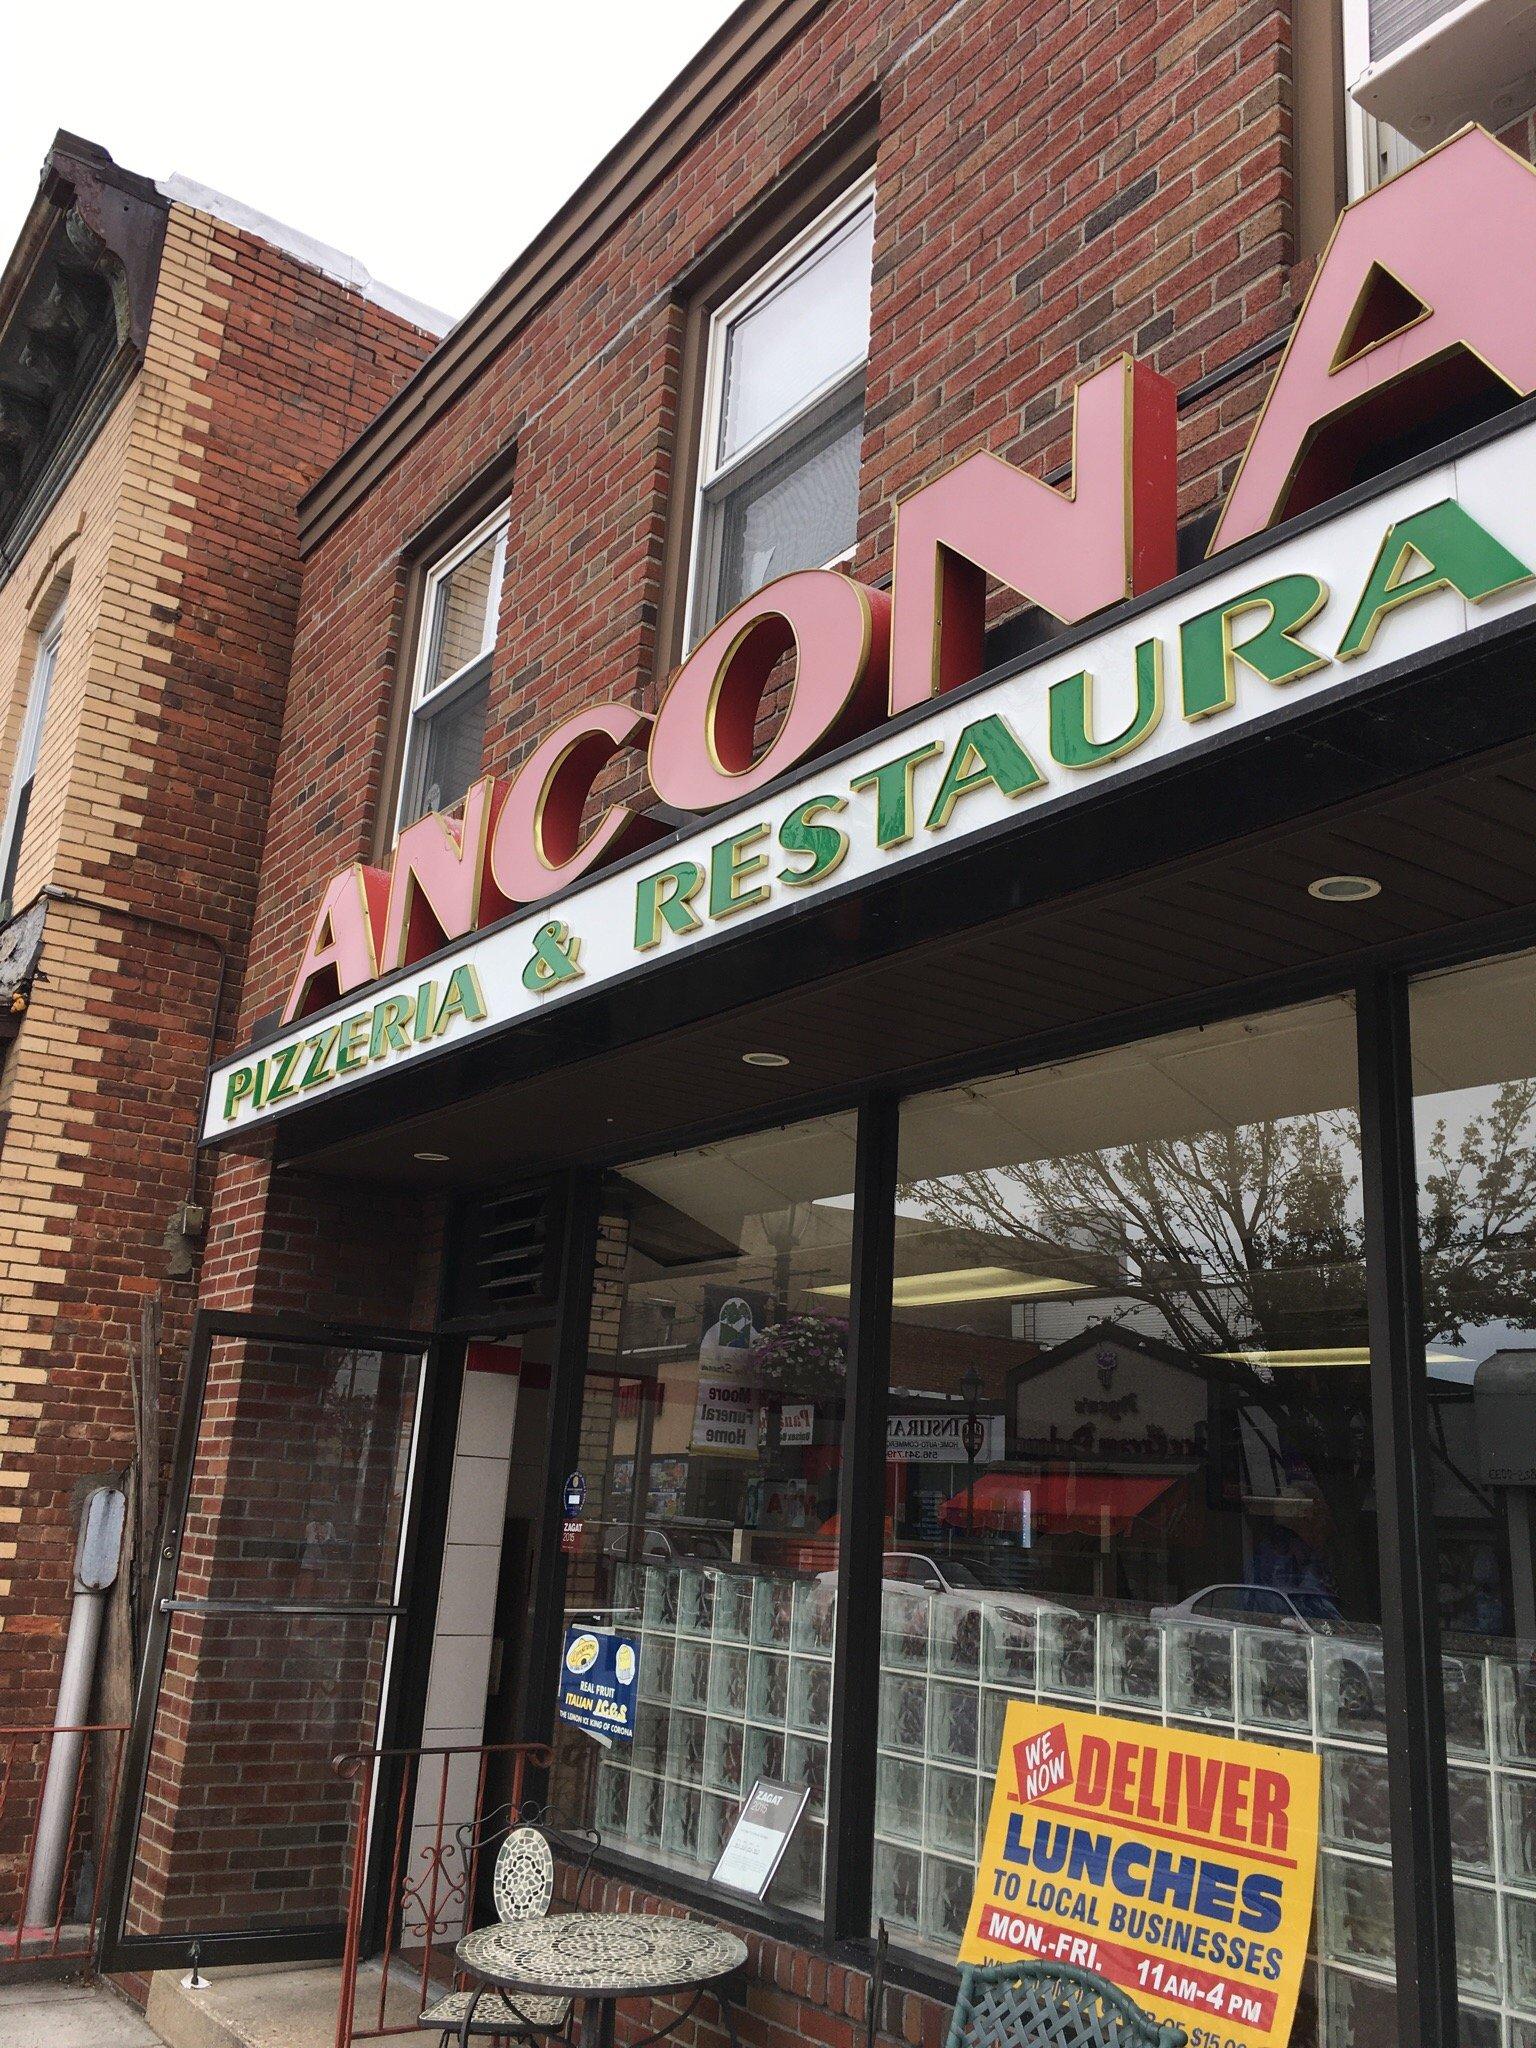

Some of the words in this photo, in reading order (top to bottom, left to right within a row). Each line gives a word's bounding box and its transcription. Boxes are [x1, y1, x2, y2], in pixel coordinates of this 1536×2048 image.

[278, 121, 1536, 1027] ANCONA
[222, 962, 489, 1121] PIZZERIA
[522, 920, 586, 992] &
[562, 1532, 575, 1542] 2015
[563, 1522, 583, 1532] ZAGAT
[565, 1692, 593, 1712] ITALIAN
[580, 1680, 595, 1694] REAL
[595, 1684, 615, 1698] FRUIT
[602, 1721, 611, 1732] OF
[1025, 1731, 1053, 1769] WE
[1026, 1751, 1065, 1800] NOW
[1074, 1734, 1291, 1851] DELIVER
[755, 1790, 785, 1806] ZAGAT
[1002, 1813, 1284, 1933] LUNCHES
[993, 1868, 1022, 1901] TO
[1027, 1879, 1100, 1927] LOCAL
[1108, 1903, 1284, 1981] BUSINESSES
[987, 1912, 1102, 1971] MON.-FRI.
[1228, 1998, 1263, 2023] PM
